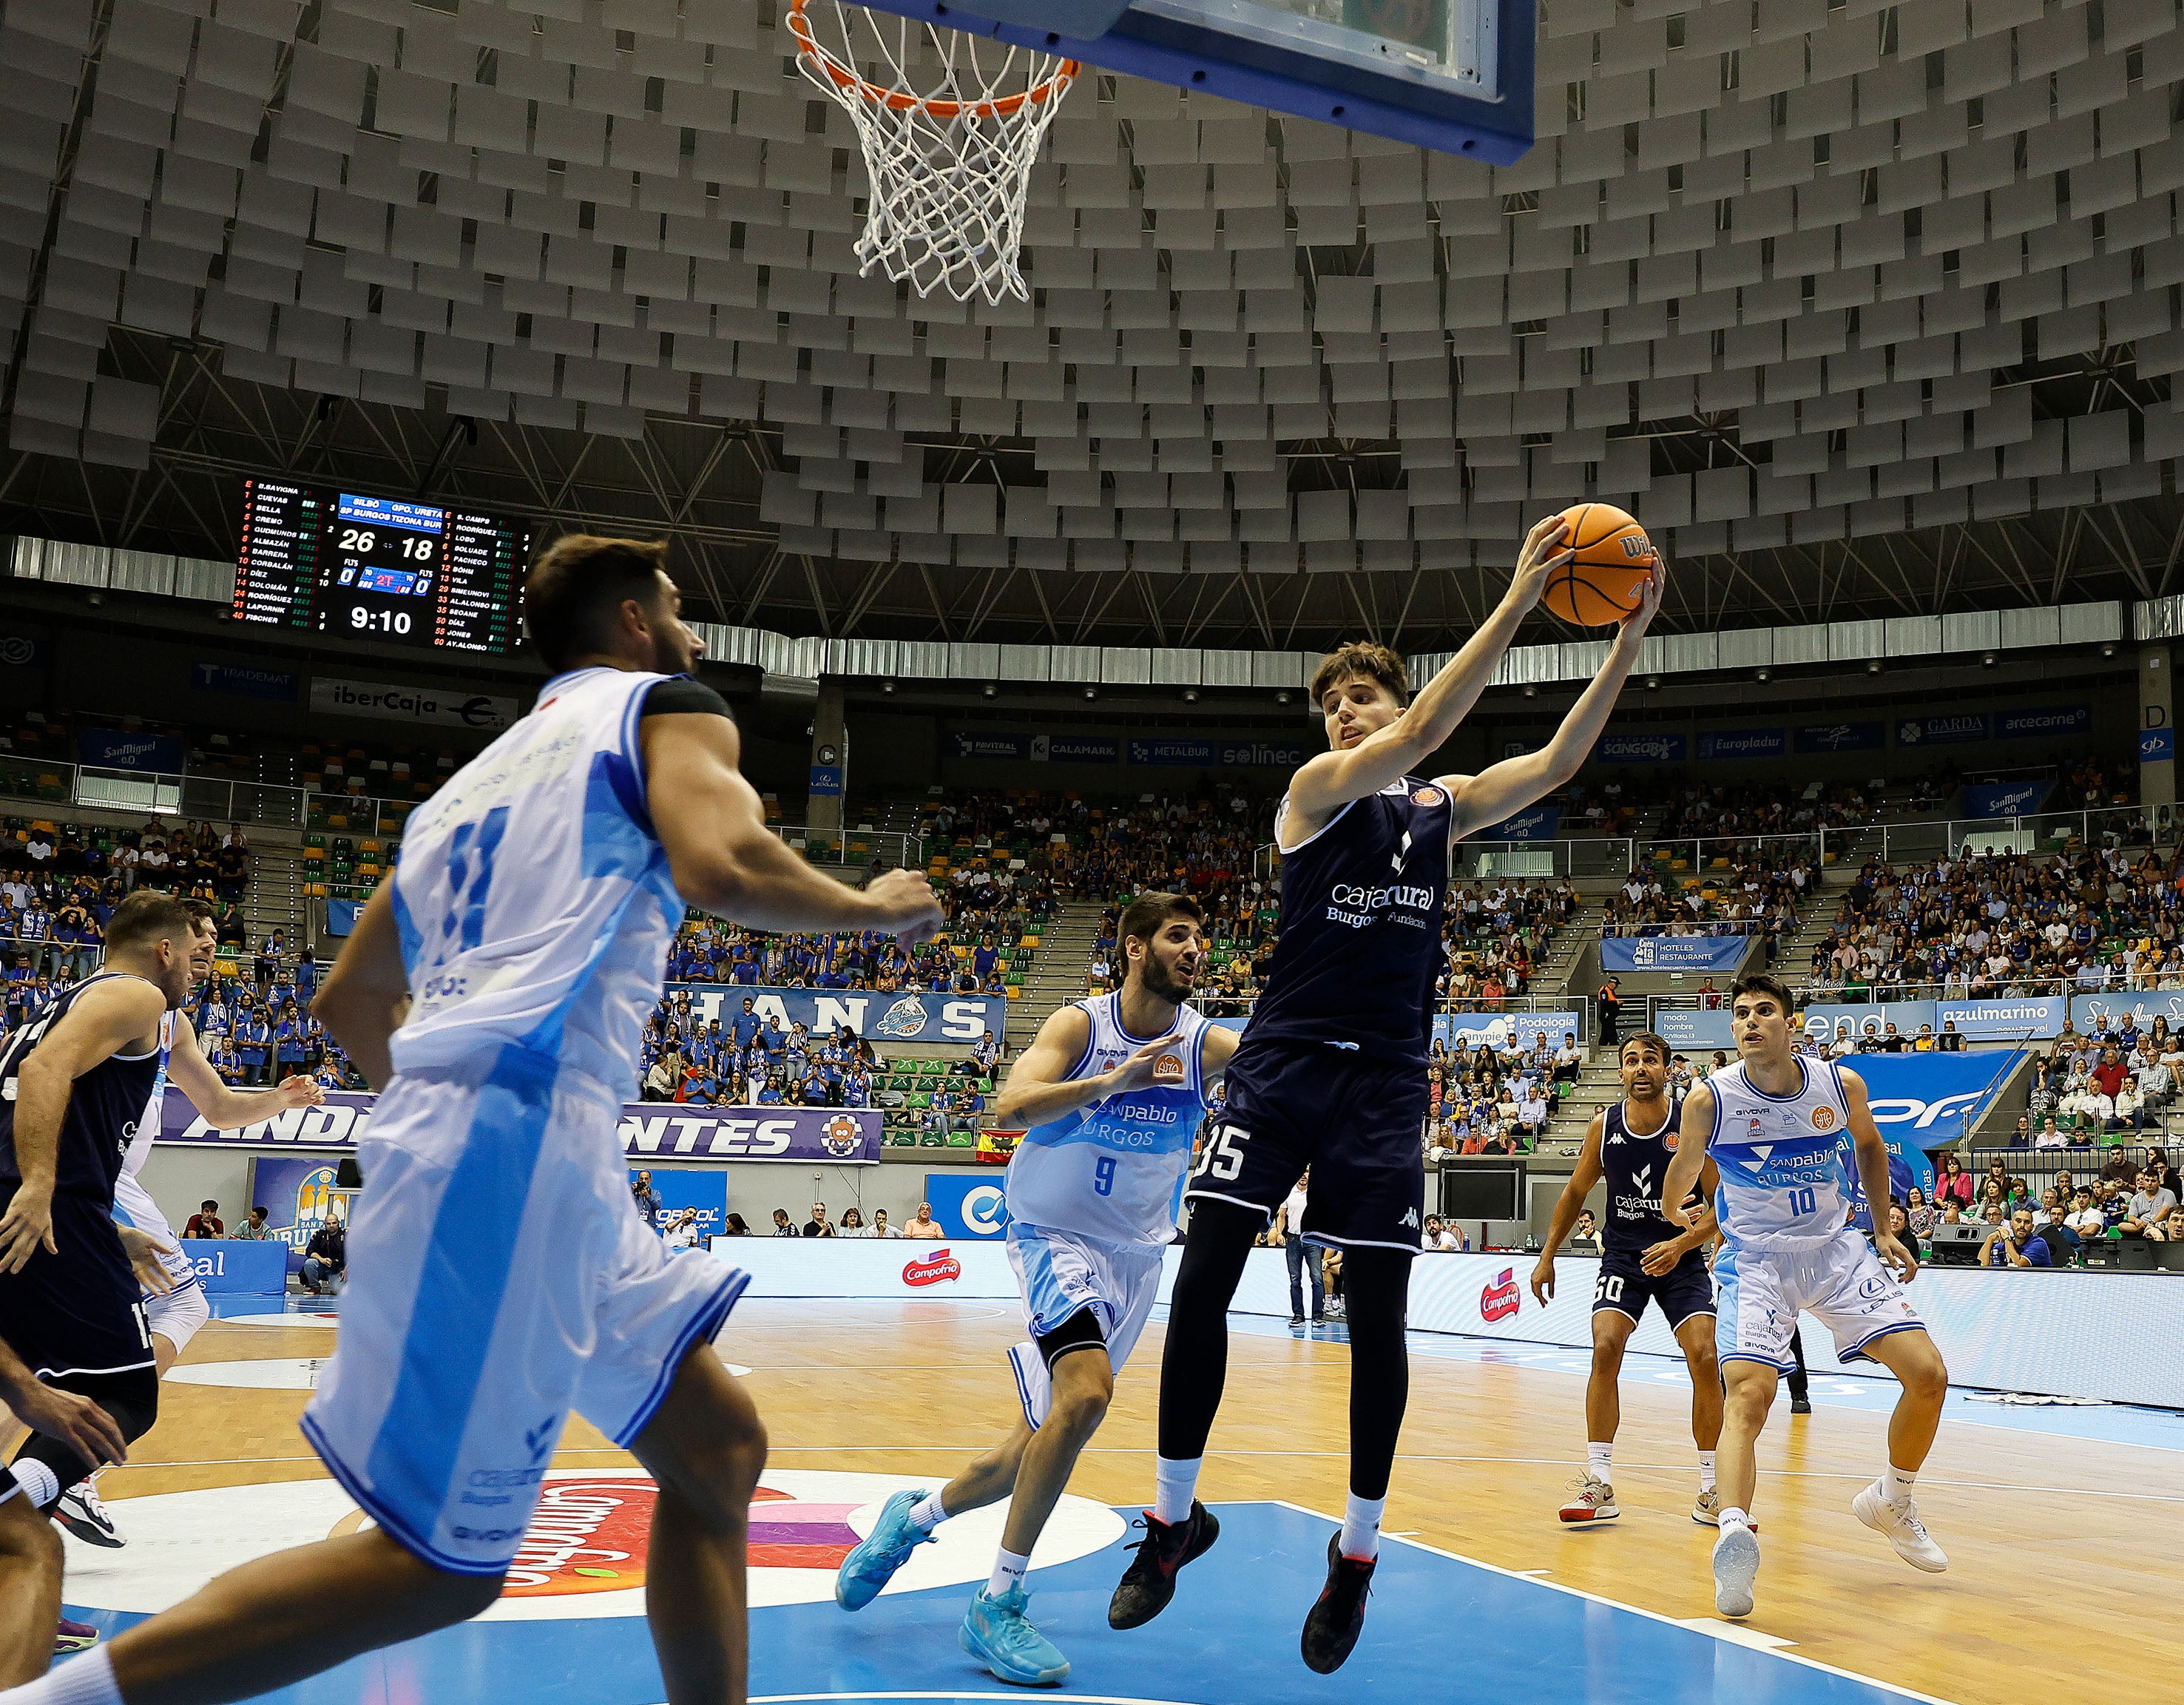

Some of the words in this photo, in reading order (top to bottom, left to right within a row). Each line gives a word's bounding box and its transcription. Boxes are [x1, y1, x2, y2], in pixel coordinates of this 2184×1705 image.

[257, 494, 288, 504] CUEVAS
[256, 505, 280, 514] BELLA
[354, 509, 391, 520] BURGOS
[391, 504, 413, 513] GPO.
[414, 507, 443, 519] URETA
[255, 516, 283, 524] CREMO
[391, 516, 422, 526] TIZONA
[423, 520, 442, 529] BUR
[465, 516, 490, 524] CAMPS
[456, 524, 497, 536] RODRÍGUEZ
[338, 529, 376, 552] 26
[456, 535, 476, 543] LOBO
[252, 548, 288, 559] BARRERA
[402, 538, 433, 560] 18
[251, 559, 293, 570] CORBALÁN
[344, 558, 359, 567] FLTS
[453, 556, 487, 566] PACHECO
[237, 567, 247, 575] 11
[250, 570, 268, 578] DÍEZ
[340, 569, 354, 583] 0
[419, 570, 433, 578] FLTS
[376, 575, 394, 587] 2T
[416, 579, 429, 593] 0
[248, 592, 292, 604] RODRÍGUEZ
[450, 598, 490, 609] AL.ALONSO
[247, 603, 285, 613] LAPORNIK
[246, 614, 278, 624] FISCHER
[351, 607, 411, 634] 9:10
[447, 630, 471, 638] JONES
[446, 641, 487, 651] AY.ALONSO
[223, 667, 291, 686] TRADEMAT
[334, 686, 437, 716] iberCaja
[2006, 713, 2075, 730] arcecarne
[2146, 705, 2166, 729] D
[1927, 715, 1983, 732] GARDA
[976, 742, 1017, 751] PAVITRAL
[1716, 736, 1781, 751] Europladur
[817, 744, 836, 766] C
[1154, 746, 1209, 757] METALBUR
[1222, 743, 1300, 765] solinec
[1942, 1004, 2049, 1023] azulmarino
[1518, 1016, 1575, 1029] Podología
[1460, 1031, 1502, 1045] Sanypie
[1518, 1030, 1526, 1040] y
[1736, 1108, 1770, 1116] GIVOVA
[1095, 1155, 1117, 1196] 9
[1788, 1186, 1816, 1217] 10
[1617, 1209, 1645, 1220] Burgos
[1861, 1290, 1904, 1314] LEXUS
[1745, 1330, 1768, 1340] Burgos
[1745, 1342, 1776, 1355] GIVOVA
